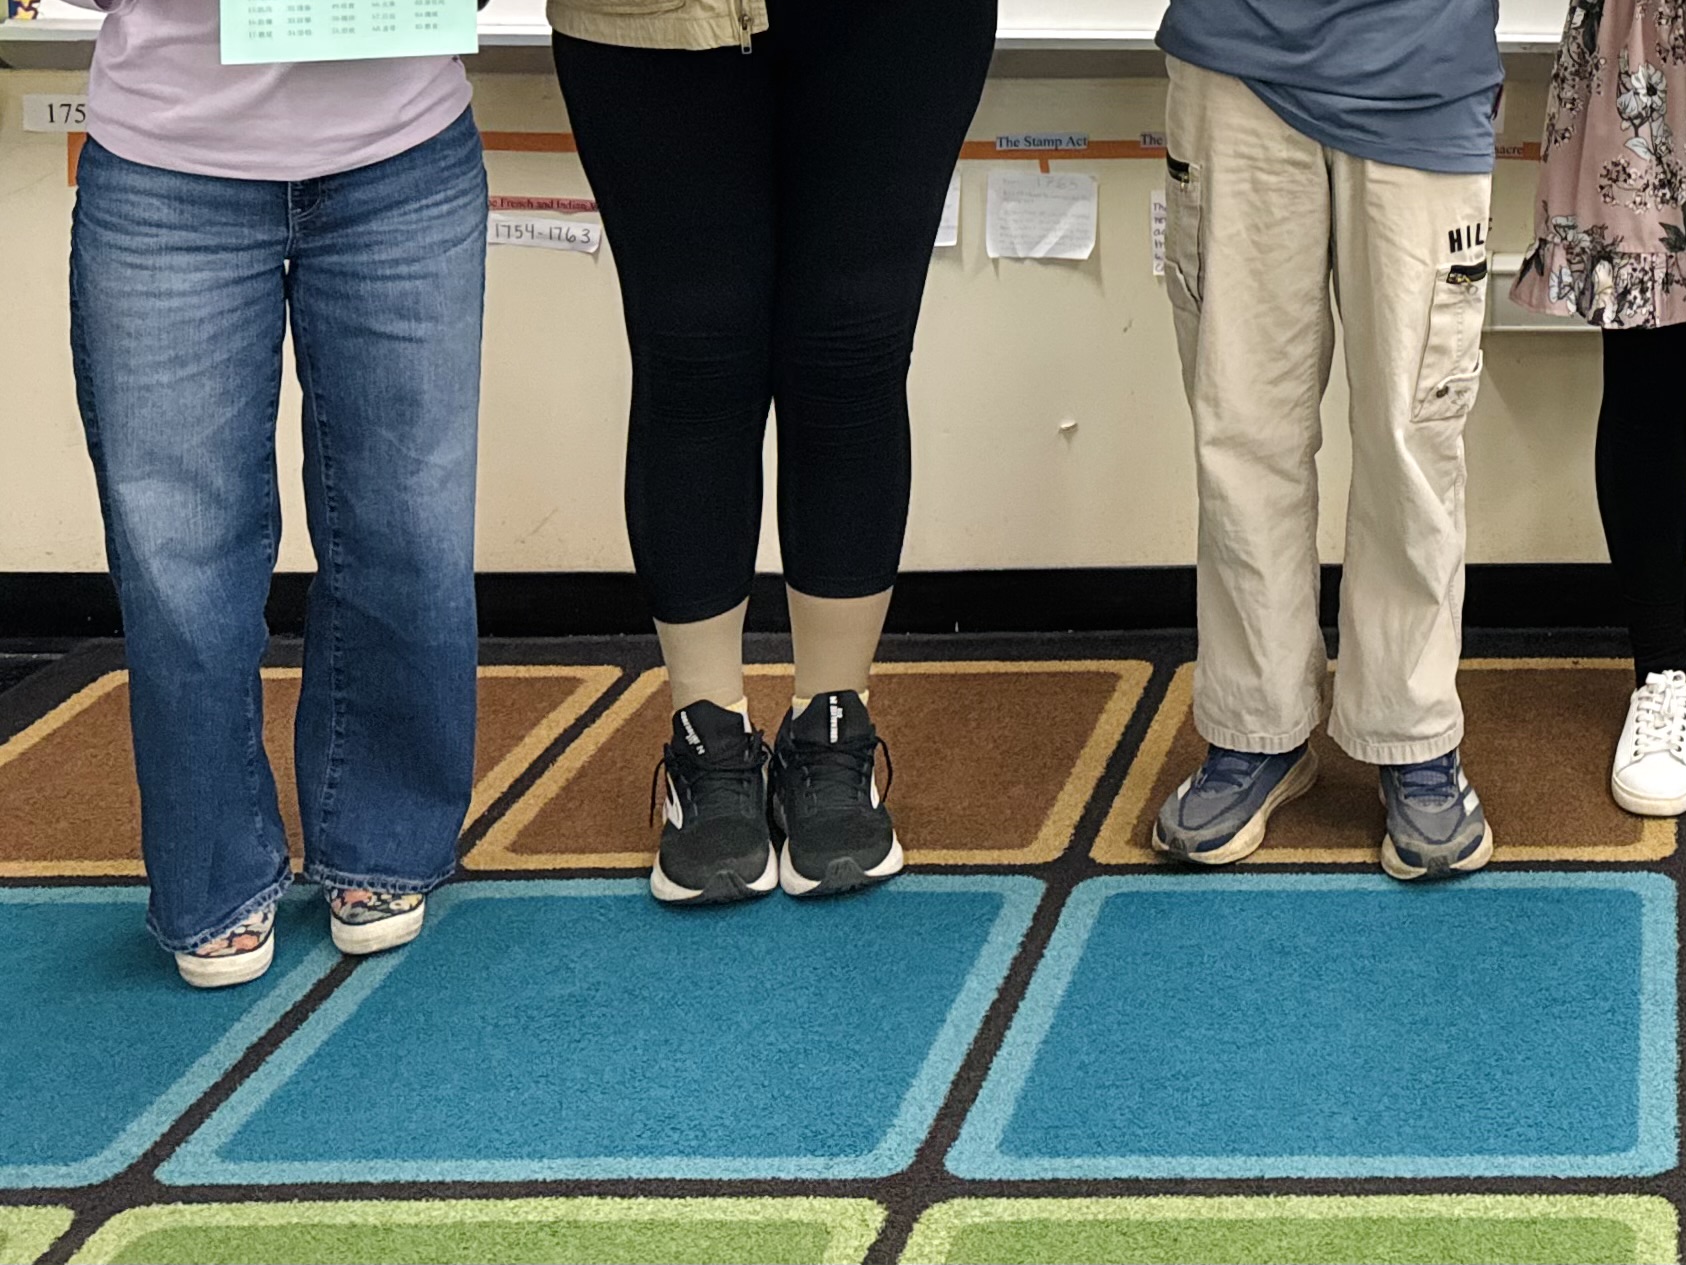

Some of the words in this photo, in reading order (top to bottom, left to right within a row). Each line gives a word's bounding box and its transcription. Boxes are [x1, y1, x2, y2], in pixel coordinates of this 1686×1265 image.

[999, 137, 1020, 148] The
[1023, 136, 1062, 151] Stamp
[1065, 136, 1088, 148] Act
[1141, 134, 1163, 146] The
[501, 197, 532, 209] French
[536, 200, 553, 209] and
[496, 223, 591, 244] 1754-1763
